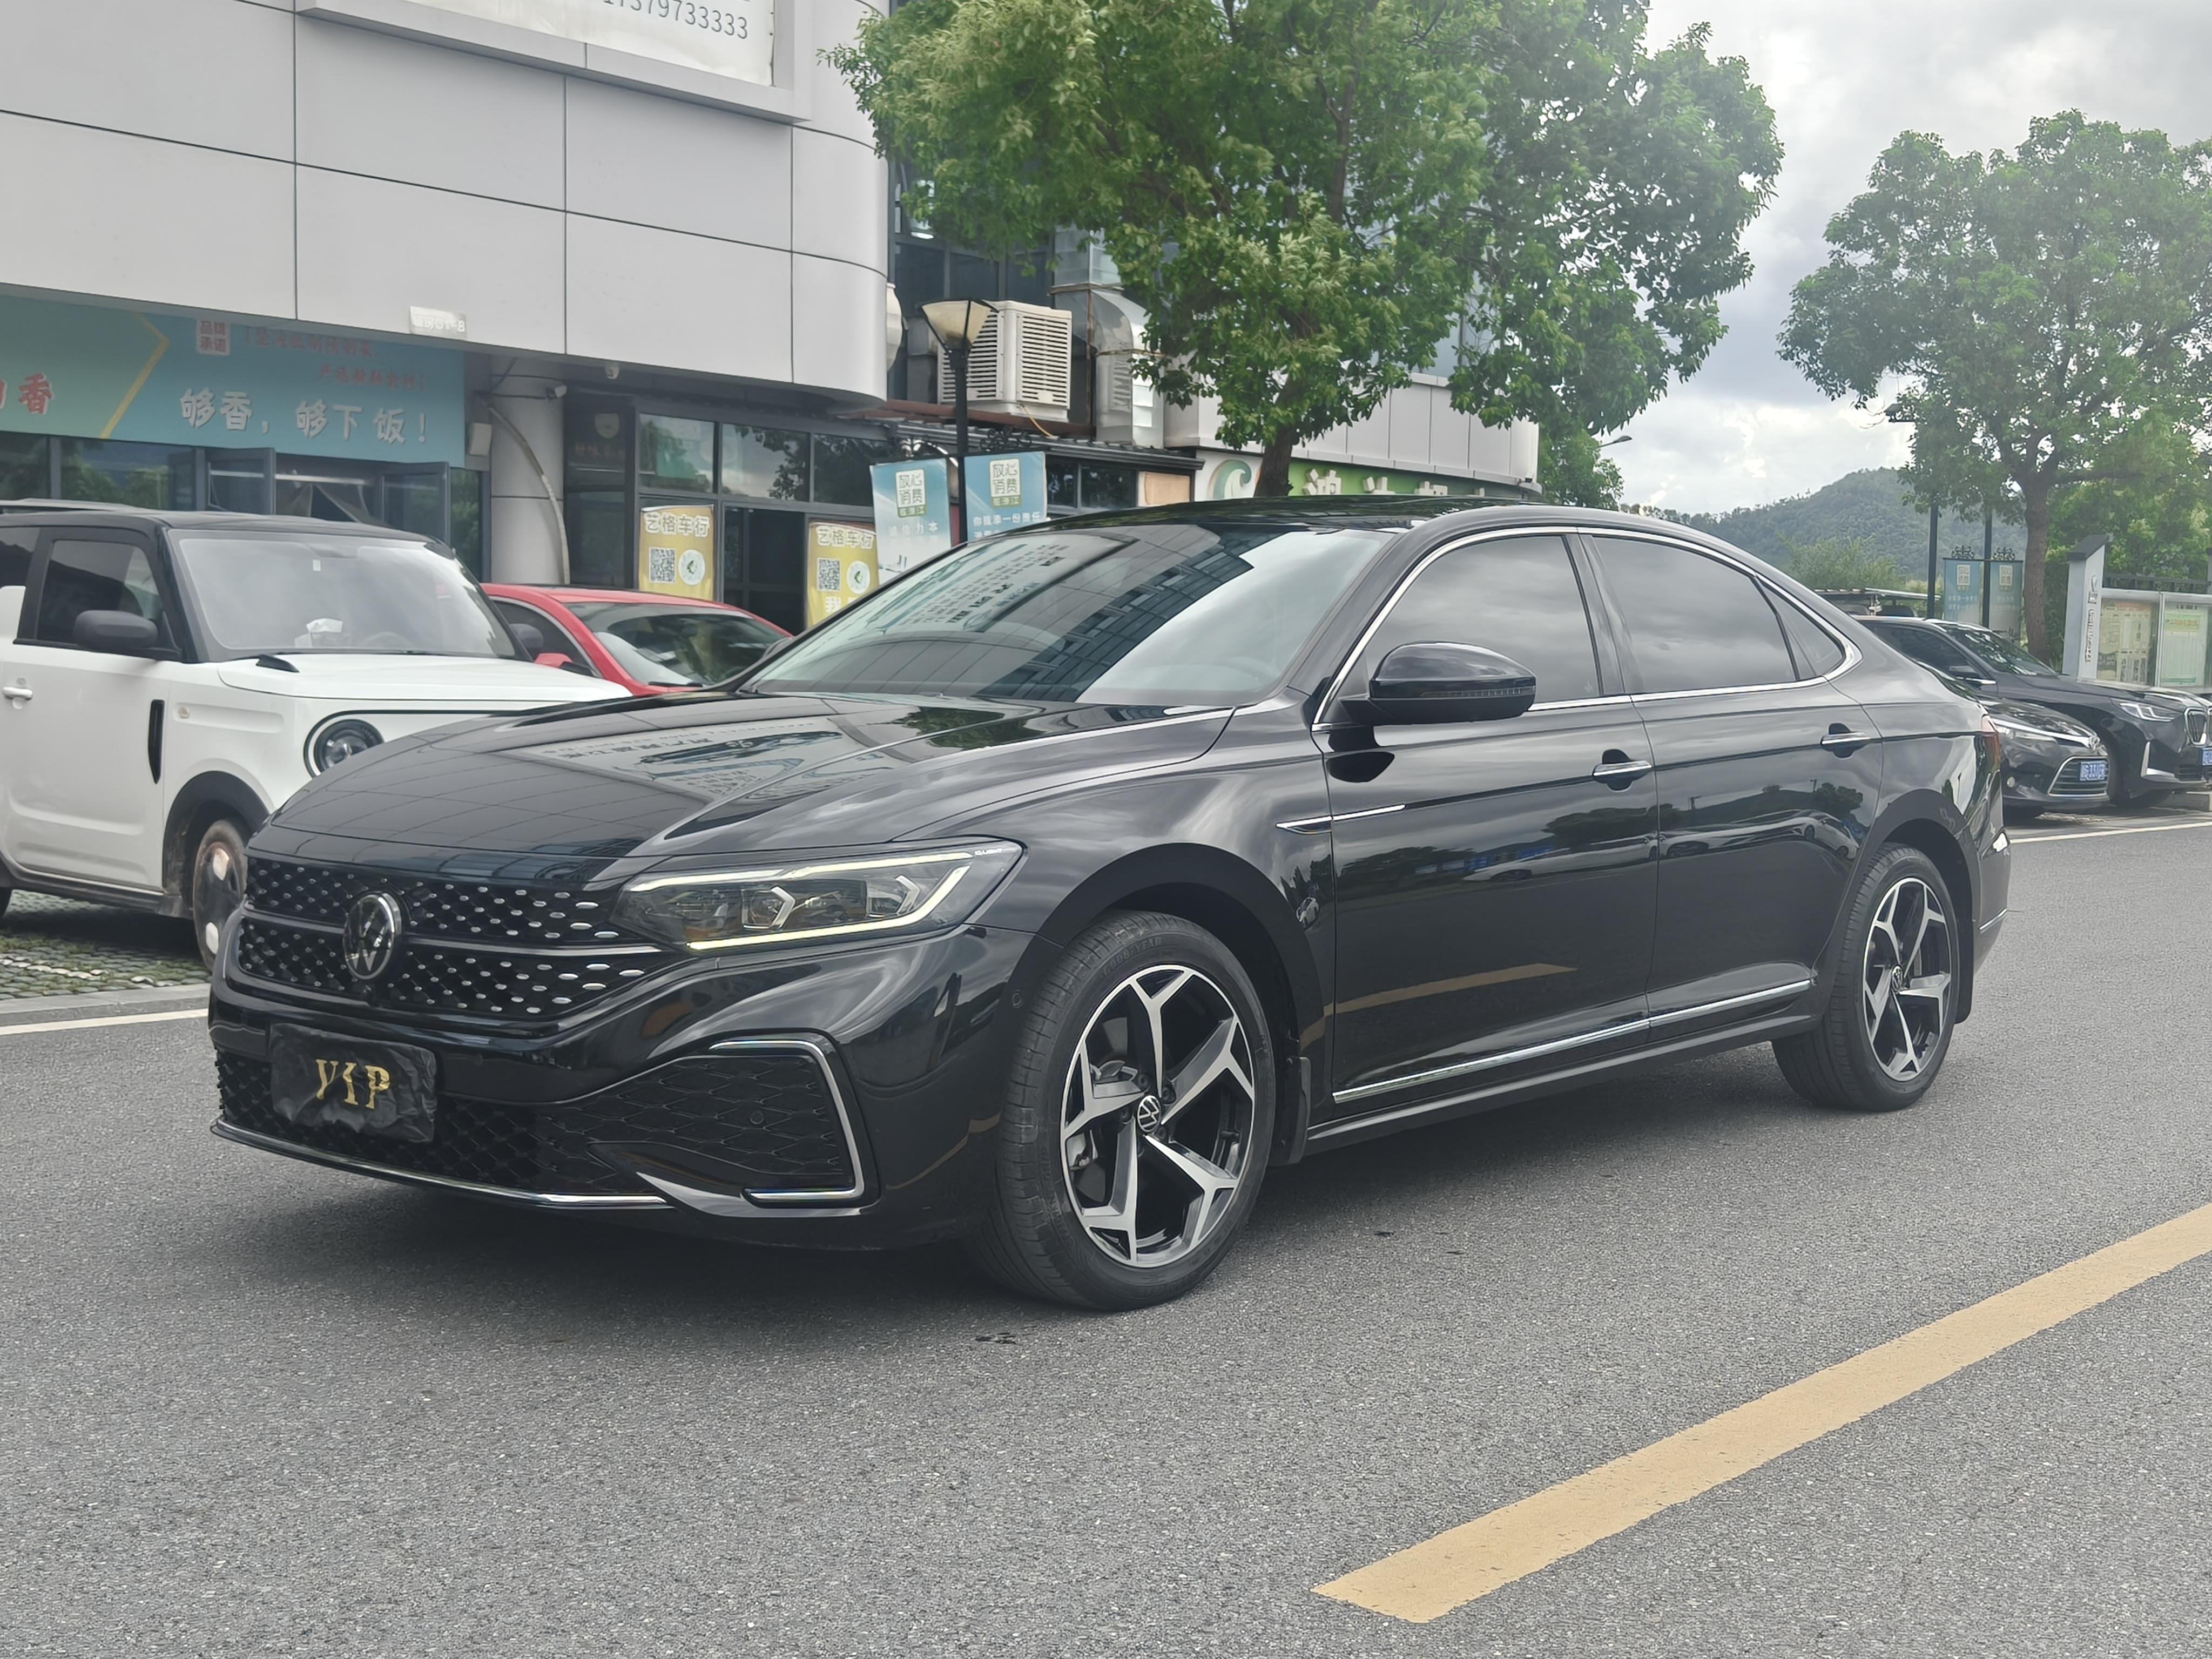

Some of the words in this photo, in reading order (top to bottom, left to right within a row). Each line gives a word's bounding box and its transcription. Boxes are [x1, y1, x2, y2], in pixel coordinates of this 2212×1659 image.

[604, 0, 748, 39] 79733333
[0, 372, 55, 415] 香
[644, 511, 710, 537] 艺格车行
[816, 525, 874, 549] 艺格车行
[315, 1059, 390, 1109] VIP
